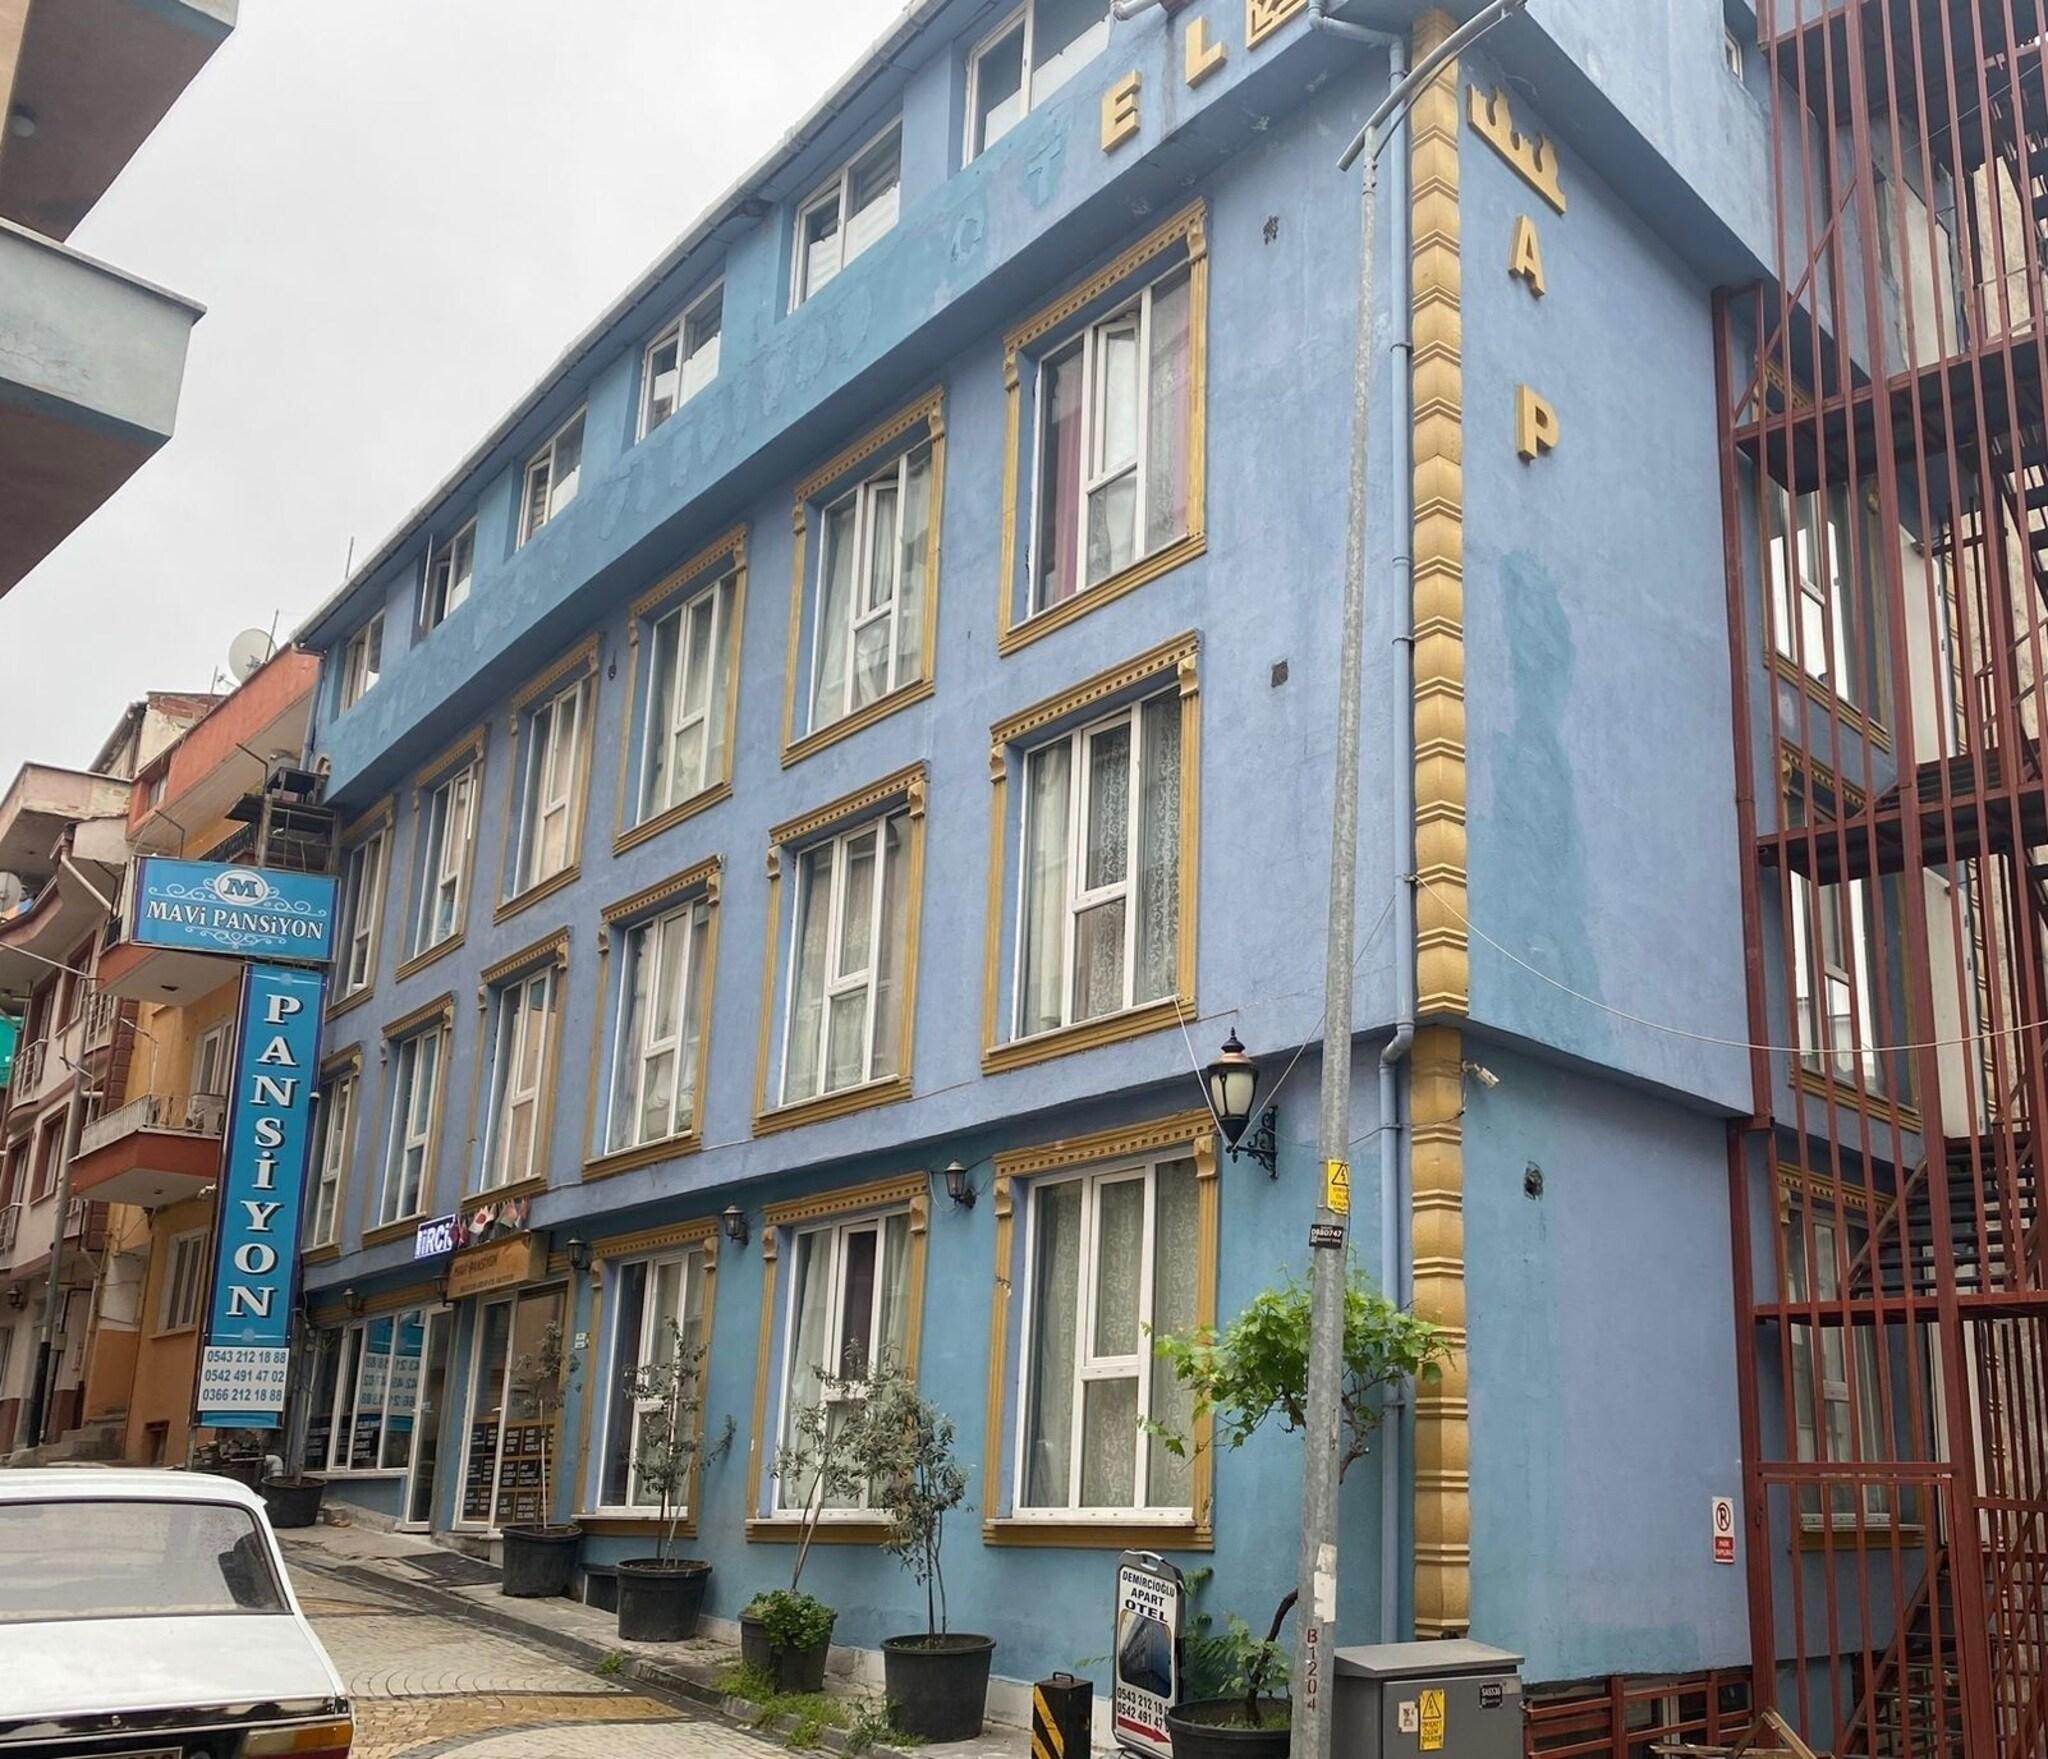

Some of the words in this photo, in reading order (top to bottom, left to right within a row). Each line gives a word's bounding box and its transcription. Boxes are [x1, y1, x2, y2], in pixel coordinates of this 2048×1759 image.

[207, 1350, 233, 1363] 0543
[236, 1351, 256, 1363] 212
[259, 1352, 272, 1364] 18
[273, 1352, 287, 1364] 88
[204, 1369, 232, 1382] 0542
[234, 1370, 253, 1382] 491
[256, 1370, 270, 1383] 47
[271, 1371, 285, 1383] 02
[202, 1388, 229, 1401] 0366
[231, 1388, 252, 1401] 212
[255, 1389, 267, 1401] 18
[269, 1389, 283, 1402] 88
[1130, 1587, 1164, 1607] APART
[1125, 1599, 1168, 1623] OTEL
[1116, 1687, 1136, 1704] 0543
[1138, 1694, 1152, 1710] 212
[1154, 1701, 1163, 1715] 18
[1116, 1701, 1136, 1719] 0542
[1138, 1710, 1152, 1725] 491
[1154, 1716, 1163, 1730] 47
